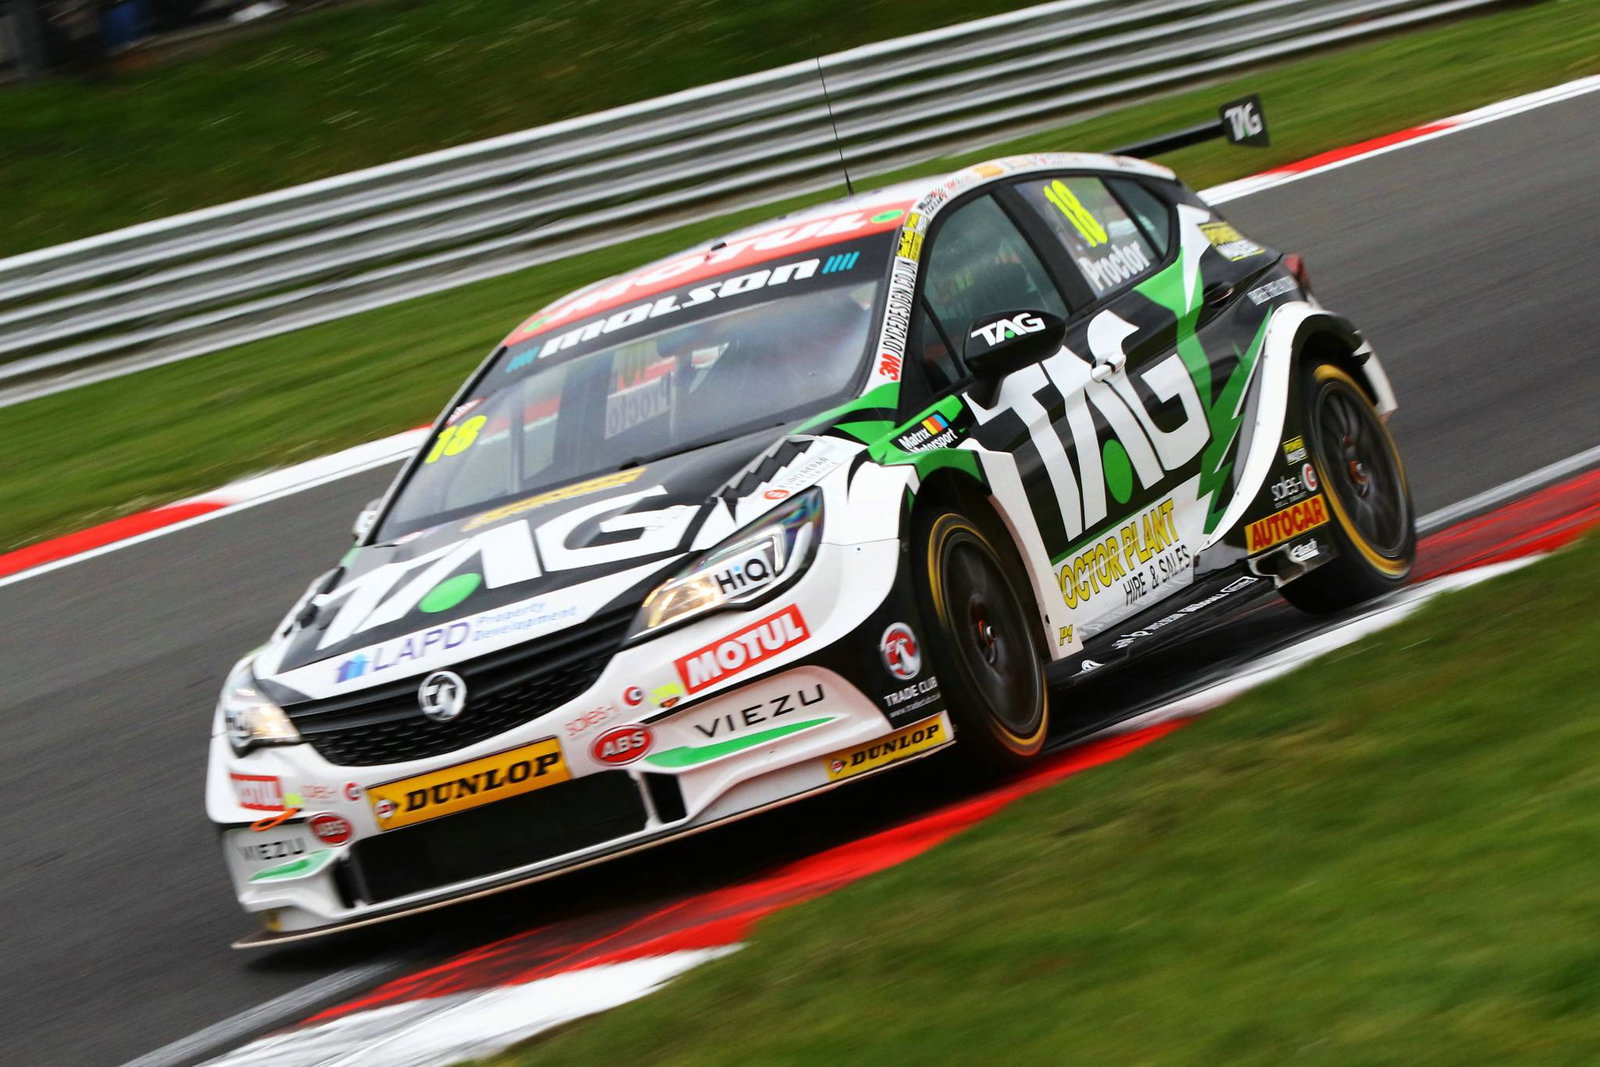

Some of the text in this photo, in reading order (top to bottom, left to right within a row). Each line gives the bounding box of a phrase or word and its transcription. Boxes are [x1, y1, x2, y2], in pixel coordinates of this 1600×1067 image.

[1224, 102, 1263, 142] TAG
[1043, 180, 1108, 248] 18
[1078, 241, 1151, 291] Proctor
[971, 312, 1046, 347] TAG
[879, 353, 900, 381] 3M
[424, 414, 488, 464] 18
[898, 428, 932, 452] Matrix
[961, 309, 1211, 542] TAG
[1252, 498, 1326, 551] AUTOCAR
[313, 485, 702, 651] TAG
[715, 559, 769, 594] HiQ
[1054, 498, 1179, 609] OCTOR PLANT
[1123, 544, 1190, 606] HIRE & SALES
[373, 621, 470, 671] LAPD
[685, 613, 803, 689] MOTUL
[695, 684, 825, 738] VIEZU
[884, 684, 919, 707] TRADE
[602, 730, 646, 758] ABS
[850, 724, 939, 767] DUNLOP
[405, 751, 560, 812] DUNLOP
